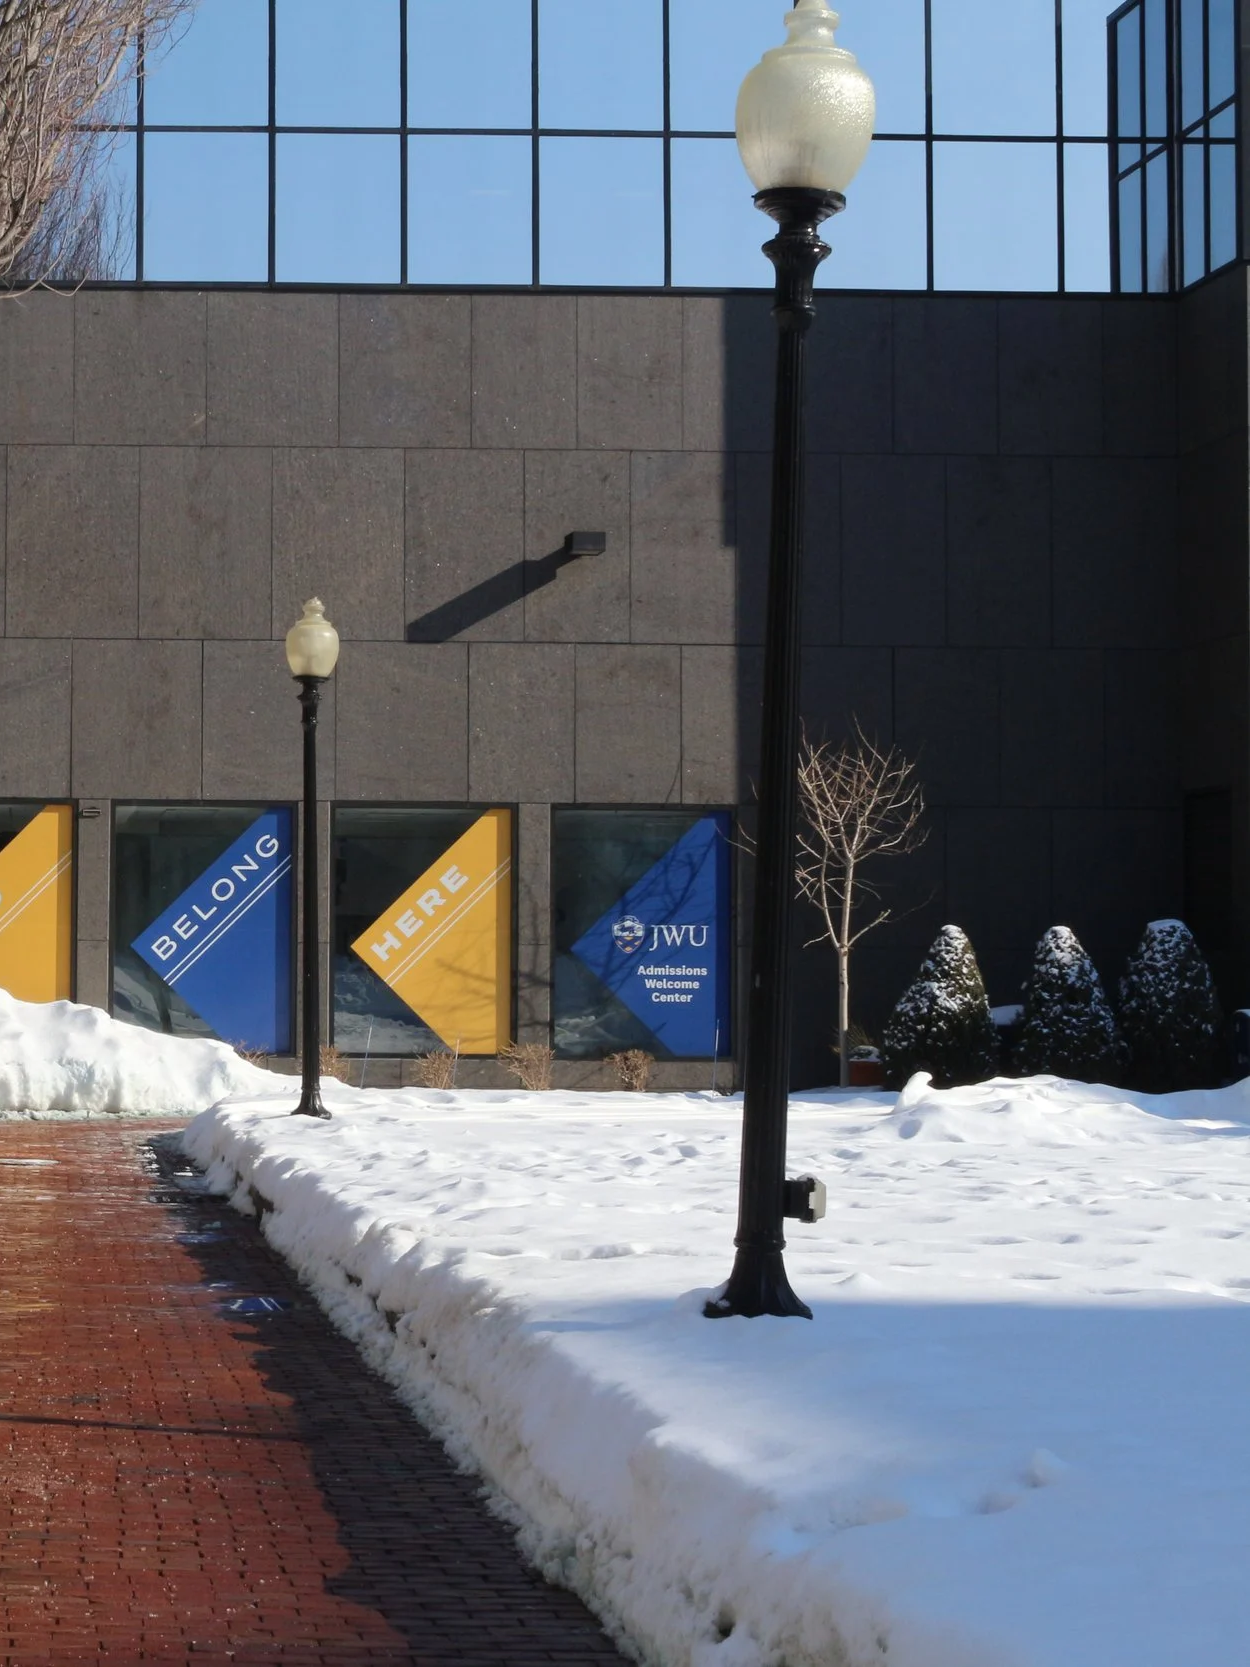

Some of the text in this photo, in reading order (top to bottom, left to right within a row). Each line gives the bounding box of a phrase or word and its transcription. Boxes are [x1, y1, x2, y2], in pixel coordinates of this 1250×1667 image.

[151, 833, 280, 962] BELONG
[369, 864, 470, 963] HERE
[649, 924, 709, 951] JWU
[637, 964, 708, 976] Admissions
[644, 978, 700, 989] Welcome
[651, 992, 693, 1003] Center
